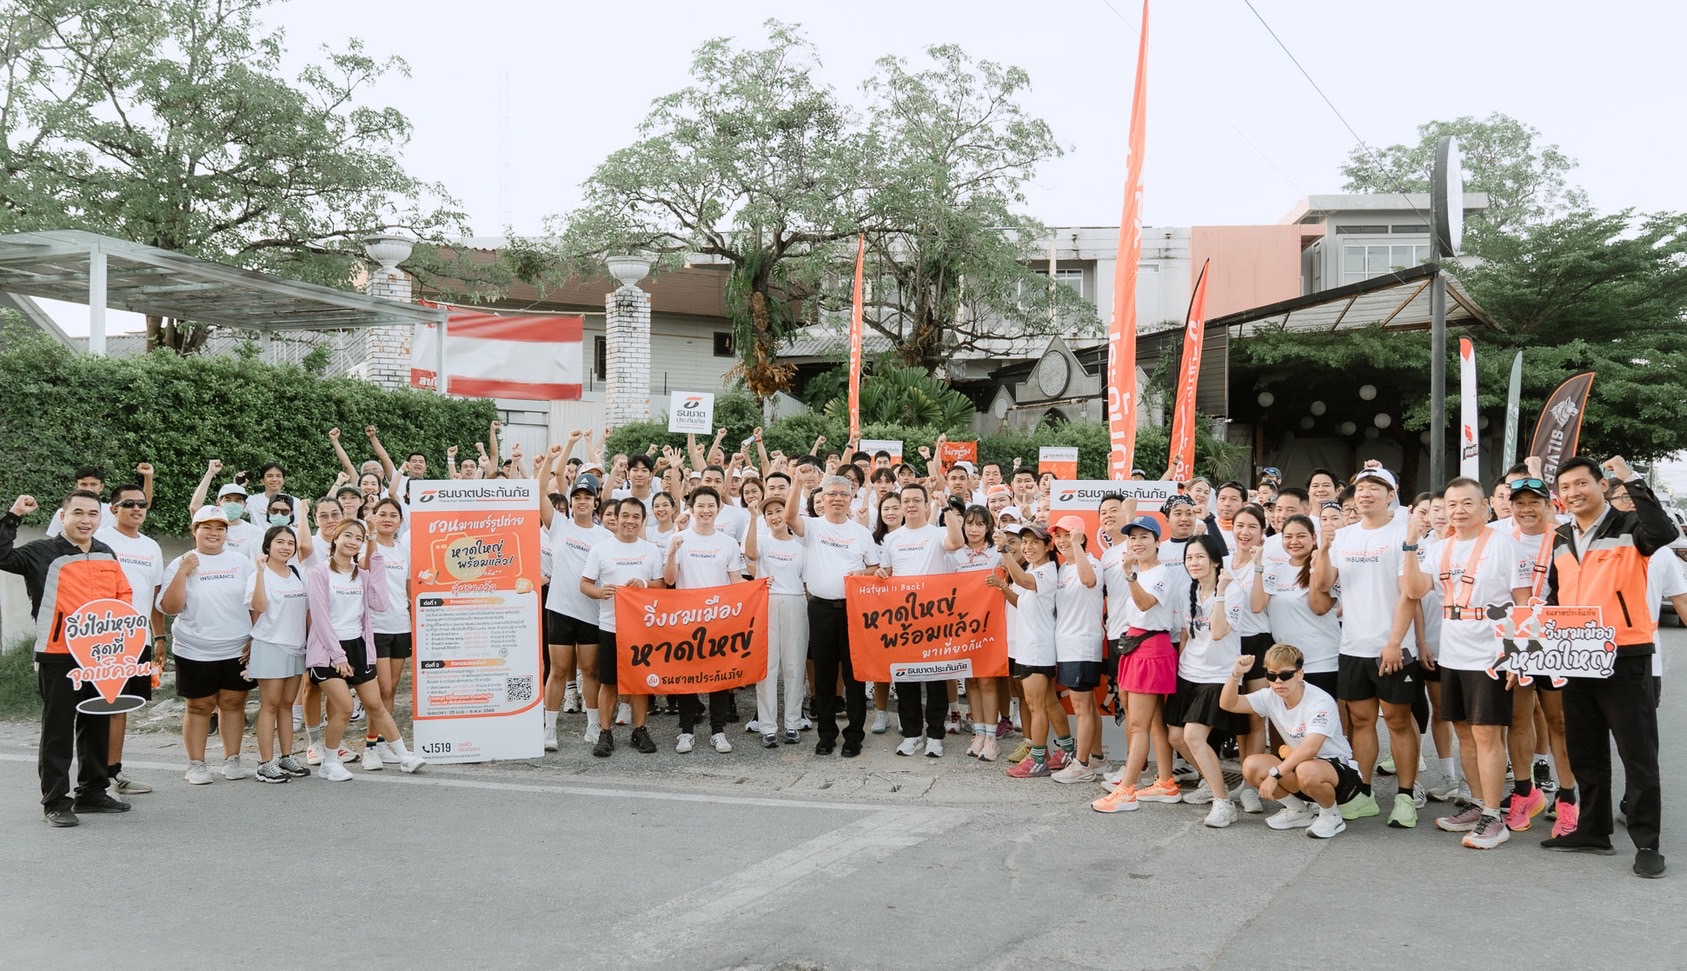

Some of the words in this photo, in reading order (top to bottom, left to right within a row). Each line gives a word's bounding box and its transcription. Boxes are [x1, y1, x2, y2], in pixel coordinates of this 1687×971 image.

[1543, 429, 1564, 484] SILVER
[438, 486, 530, 498] ธนชาตประกันภัย
[429, 513, 525, 534] ชวนมาแชร์รูปถ่าย
[451, 539, 504, 558] หาดใหญ่
[821, 540, 849, 549] INSURANCE
[119, 558, 152, 567] INSURANCE
[457, 552, 514, 569] พร้อมแล้ว!
[200, 574, 235, 582] INSURANCE
[859, 585, 889, 596] Hatyai
[900, 582, 925, 591] Back!
[643, 595, 743, 627] วิ่งชมเมือง
[862, 587, 957, 630] หาดใหญ่
[1546, 608, 1596, 617] ธนชาตประกันภัย
[67, 611, 148, 638] วิ่งไม่หยุด
[880, 611, 991, 649] พร้อมแล้ว!
[1544, 618, 1614, 640] วิ่งชมเมือง
[91, 632, 125, 661] สุดที่
[630, 616, 755, 667] หาดใหญ่
[1510, 640, 1615, 676] หาดใหญ่
[67, 657, 151, 690] จุดเช็คอิน
[661, 667, 743, 685] ธนชาตประกันภัย
[907, 662, 968, 675] ธนชาตประกันภัย
[430, 742, 451, 753] 1519
